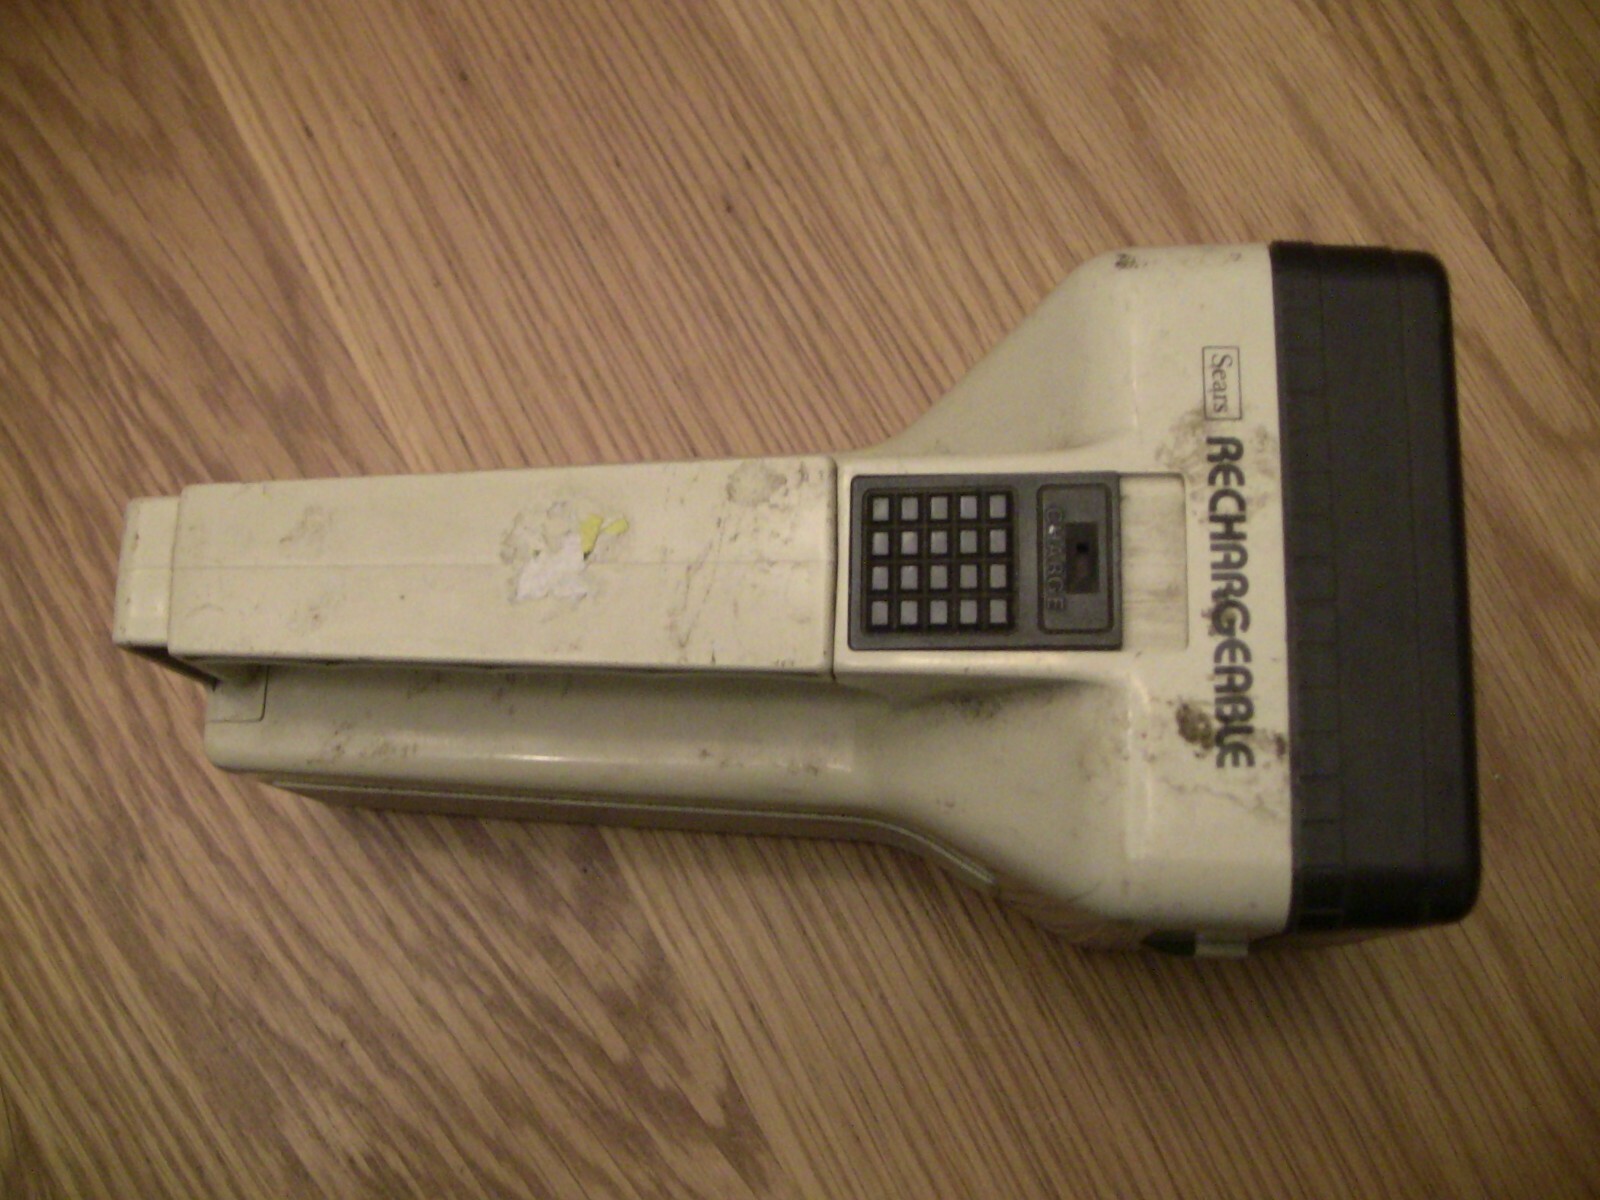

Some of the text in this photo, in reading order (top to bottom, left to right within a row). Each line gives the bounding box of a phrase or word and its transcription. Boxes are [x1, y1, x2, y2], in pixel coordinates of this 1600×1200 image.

[1208, 353, 1234, 414] Sears
[1045, 504, 1066, 611] CHARGE
[1206, 436, 1255, 769] RECHARGEABLE
